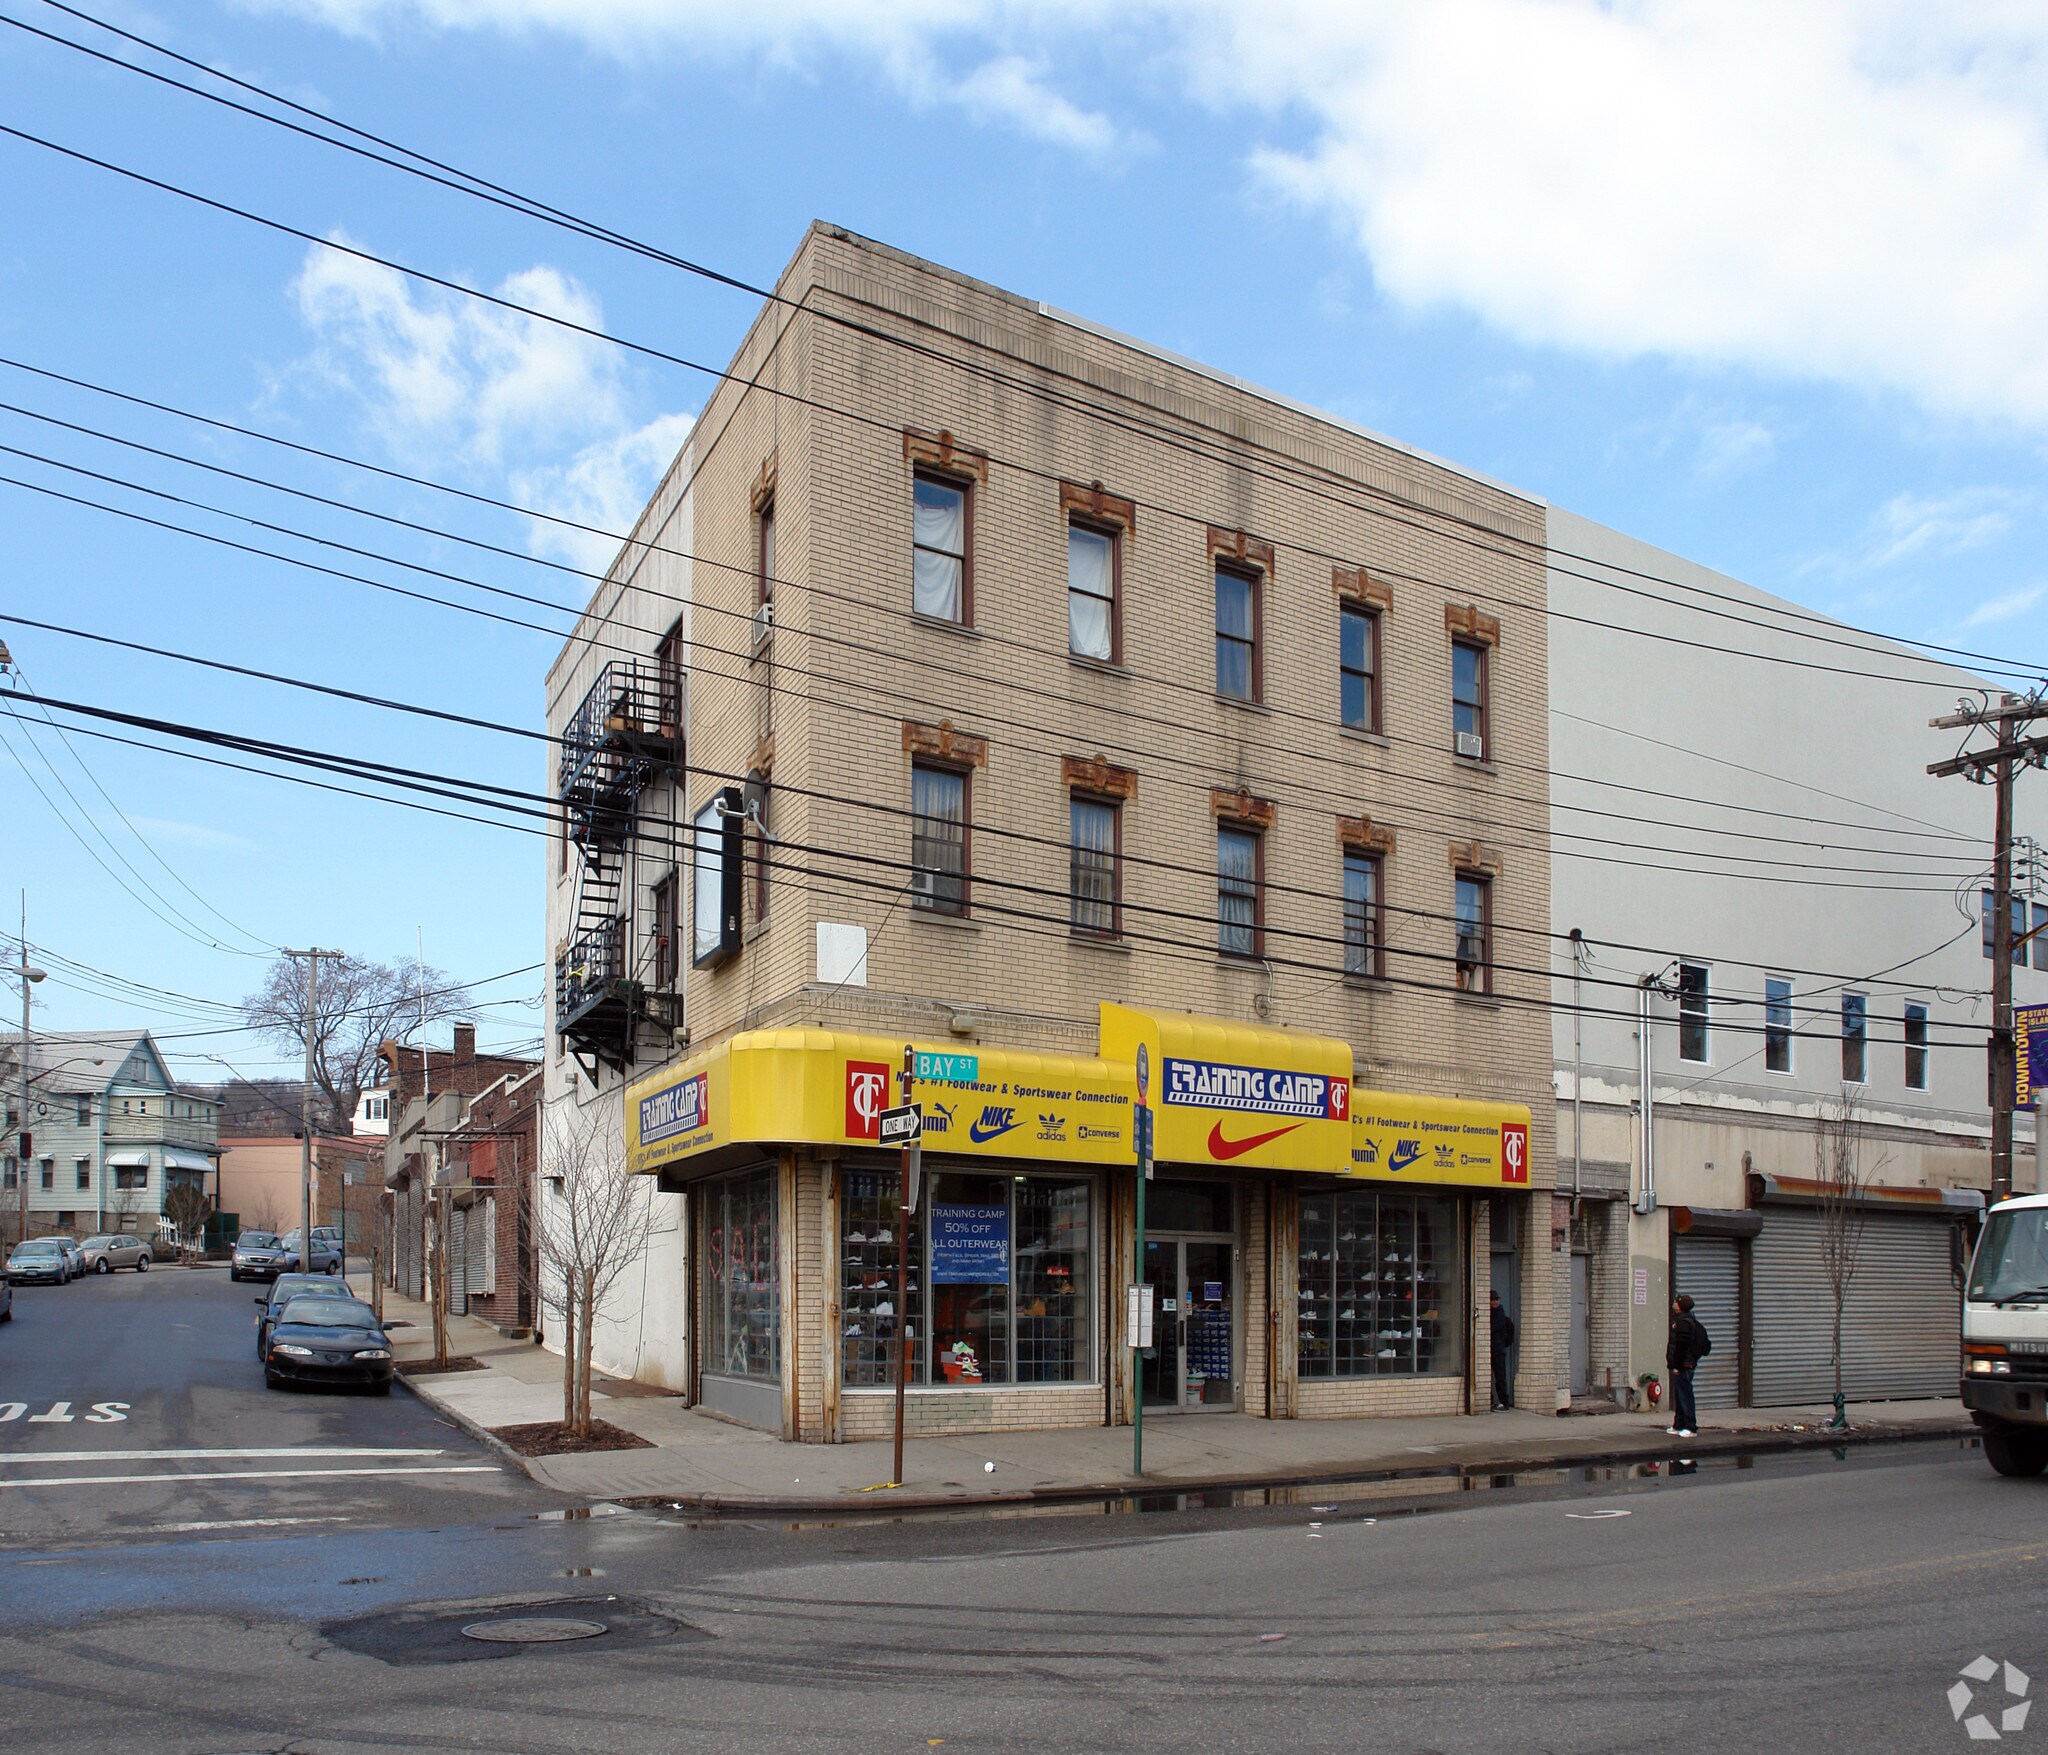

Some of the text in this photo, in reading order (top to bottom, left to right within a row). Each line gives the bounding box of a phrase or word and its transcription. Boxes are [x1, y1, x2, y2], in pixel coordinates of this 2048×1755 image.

[2016, 1011, 2029, 1105] DOWNTOWN
[920, 1056, 973, 1077] BAY ST
[947, 1079, 997, 1093] Footwear
[1001, 1083, 1008, 1094] &
[1013, 1084, 1072, 1100] Sportswear
[1075, 1090, 1129, 1104] Connection
[1269, 1074, 1325, 1104] CAMP
[885, 1115, 916, 1133] ONE WAY
[979, 1105, 1016, 1128] NIKE
[1352, 1114, 1363, 1124] C's
[1377, 1117, 1410, 1129] Footwear
[1413, 1120, 1418, 1129] &
[1421, 1121, 1461, 1133] Sportswear
[1462, 1124, 1499, 1136] Connection
[1036, 1131, 1066, 1142] adidas
[1088, 1129, 1120, 1139] CONVERSE
[1352, 1149, 1375, 1163] UMA
[1394, 1139, 1421, 1157] NIKE
[1433, 1159, 1455, 1168] adidas
[931, 1208, 1006, 1219] TRAINING CAMP
[945, 1222, 991, 1233] 50% OFF
[948, 1239, 1008, 1249] OUTERWEAR
[2010, 1343, 2048, 1353] MITSU
